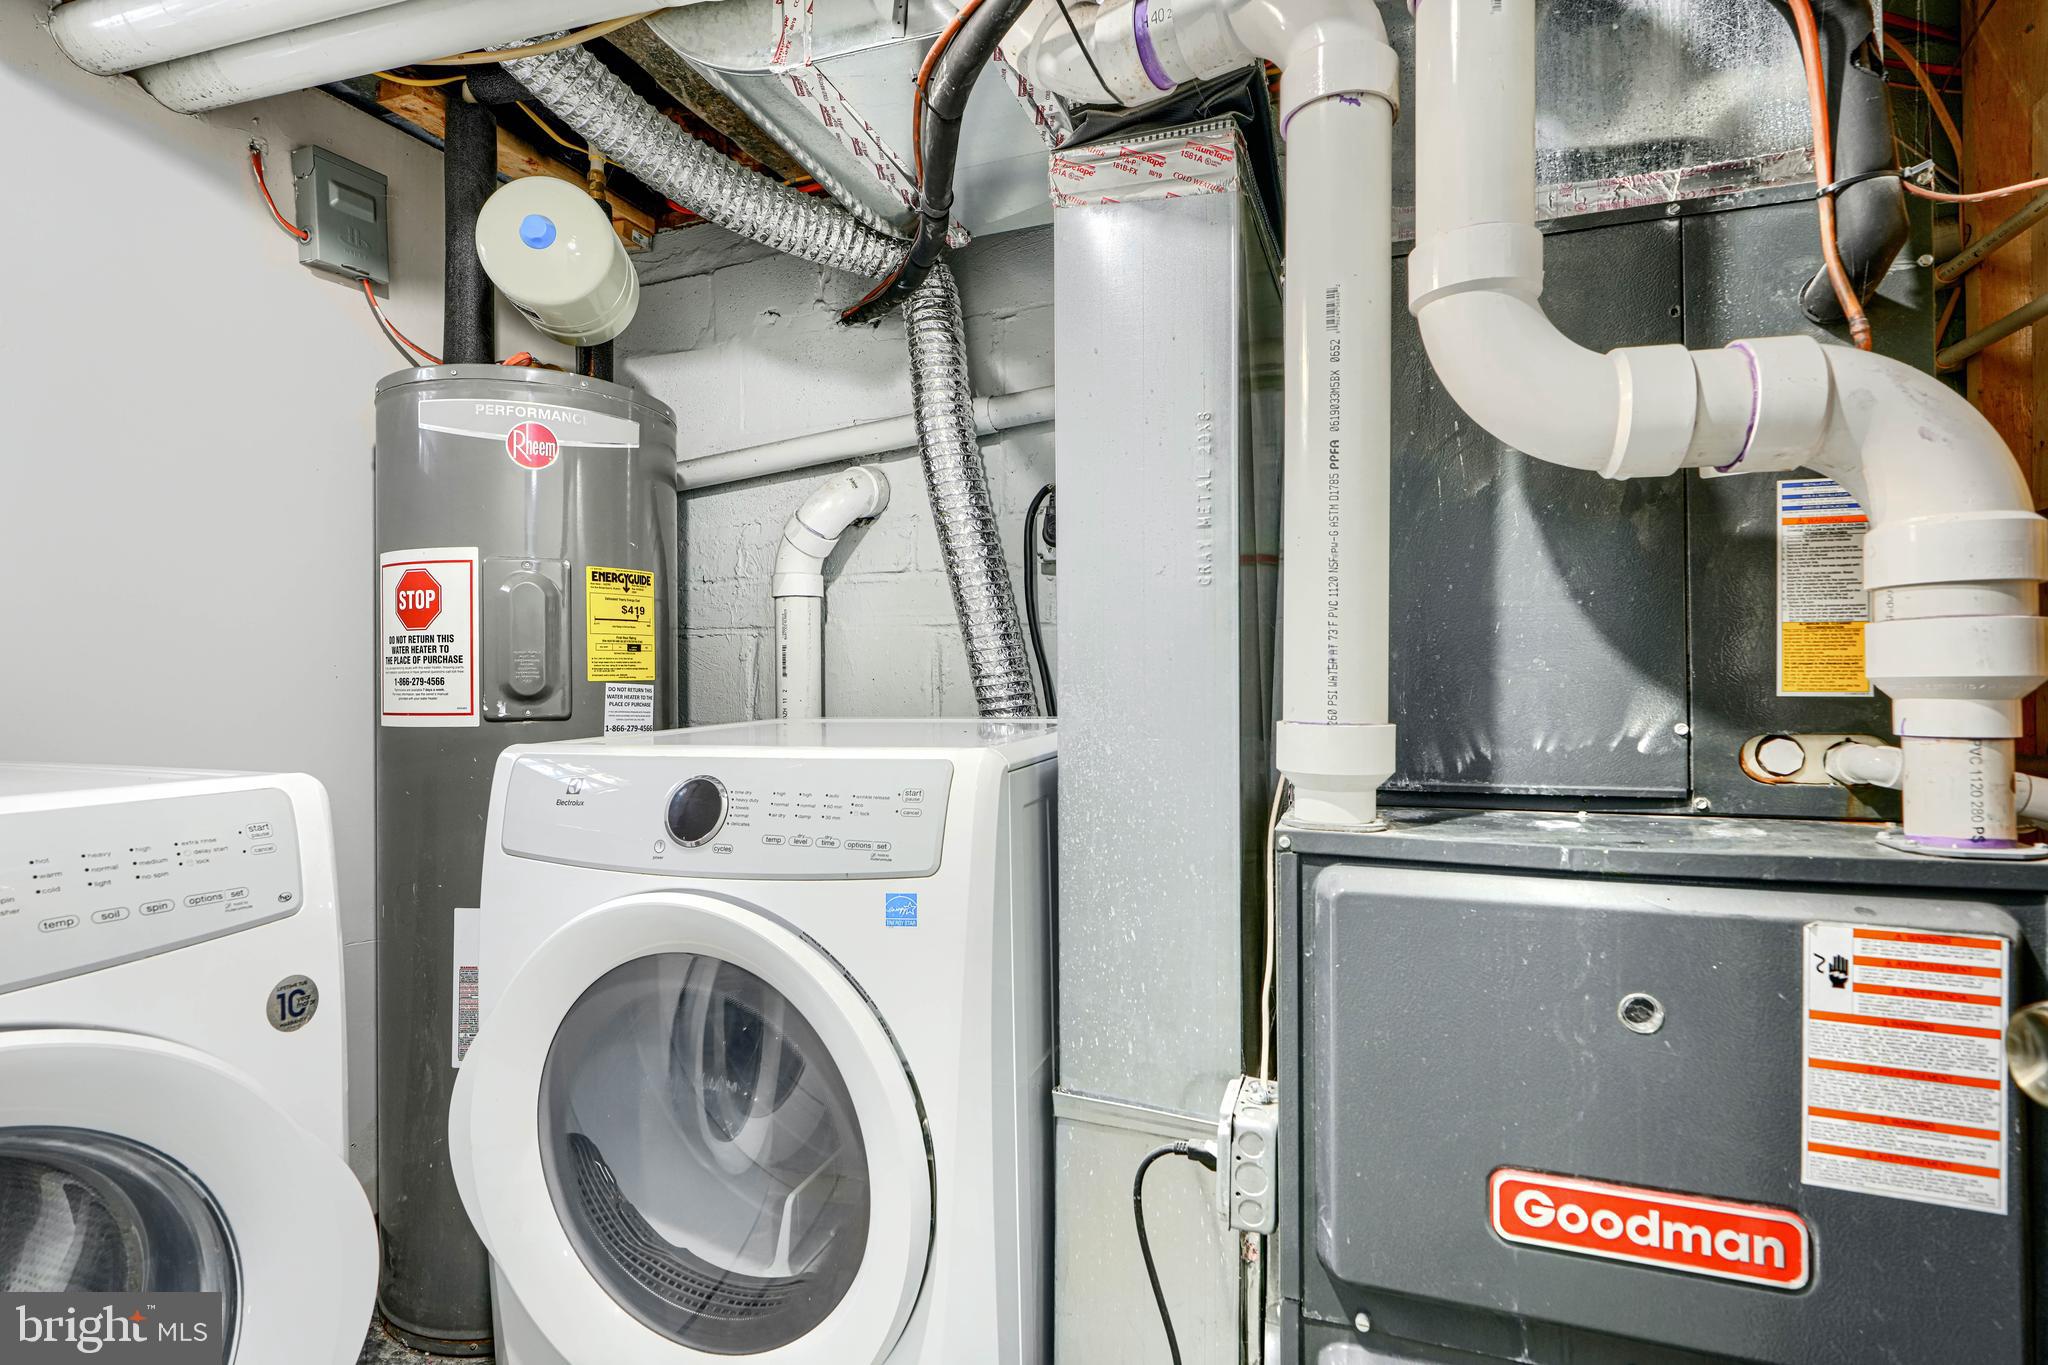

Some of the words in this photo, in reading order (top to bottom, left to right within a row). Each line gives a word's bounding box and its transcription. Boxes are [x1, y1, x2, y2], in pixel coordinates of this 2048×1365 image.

[1180, 150, 1203, 163] 1581A
[1330, 339, 1340, 362] 0652
[512, 422, 556, 462] Rheem
[1329, 439, 1340, 470] PPFA
[1328, 472, 1339, 501] D1785
[1328, 504, 1339, 528] ASTM
[592, 571, 652, 586] ENERGYGUIDE
[1328, 576, 1338, 598] 1120
[399, 590, 436, 610] STOP
[622, 606, 645, 615] $419
[1328, 600, 1338, 618] PVC
[389, 636, 396, 644] DO
[396, 636, 406, 644] NOT
[408, 635, 434, 643] RETURN
[437, 634, 454, 643] THIS
[392, 646, 409, 654] WATER
[411, 645, 437, 654] HEATER
[440, 645, 449, 653] TO
[394, 656, 410, 664] PLACE
[413, 656, 421, 664] OF
[423, 655, 463, 664] PURCHASE
[1328, 656, 1338, 688] WATER
[394, 677, 445, 686] 1-866-279-4566
[1328, 690, 1338, 707] PSI
[1970, 801, 1984, 822] 280
[248, 823, 270, 832] start
[40, 871, 62, 879] warm
[91, 864, 119, 872] normal
[42, 886, 61, 894] cold
[189, 893, 223, 905] options
[230, 890, 244, 898] set
[146, 902, 168, 912] spin
[101, 910, 120, 920] soil
[43, 918, 74, 930] temp
[1514, 1189, 1785, 1268] Goodman
